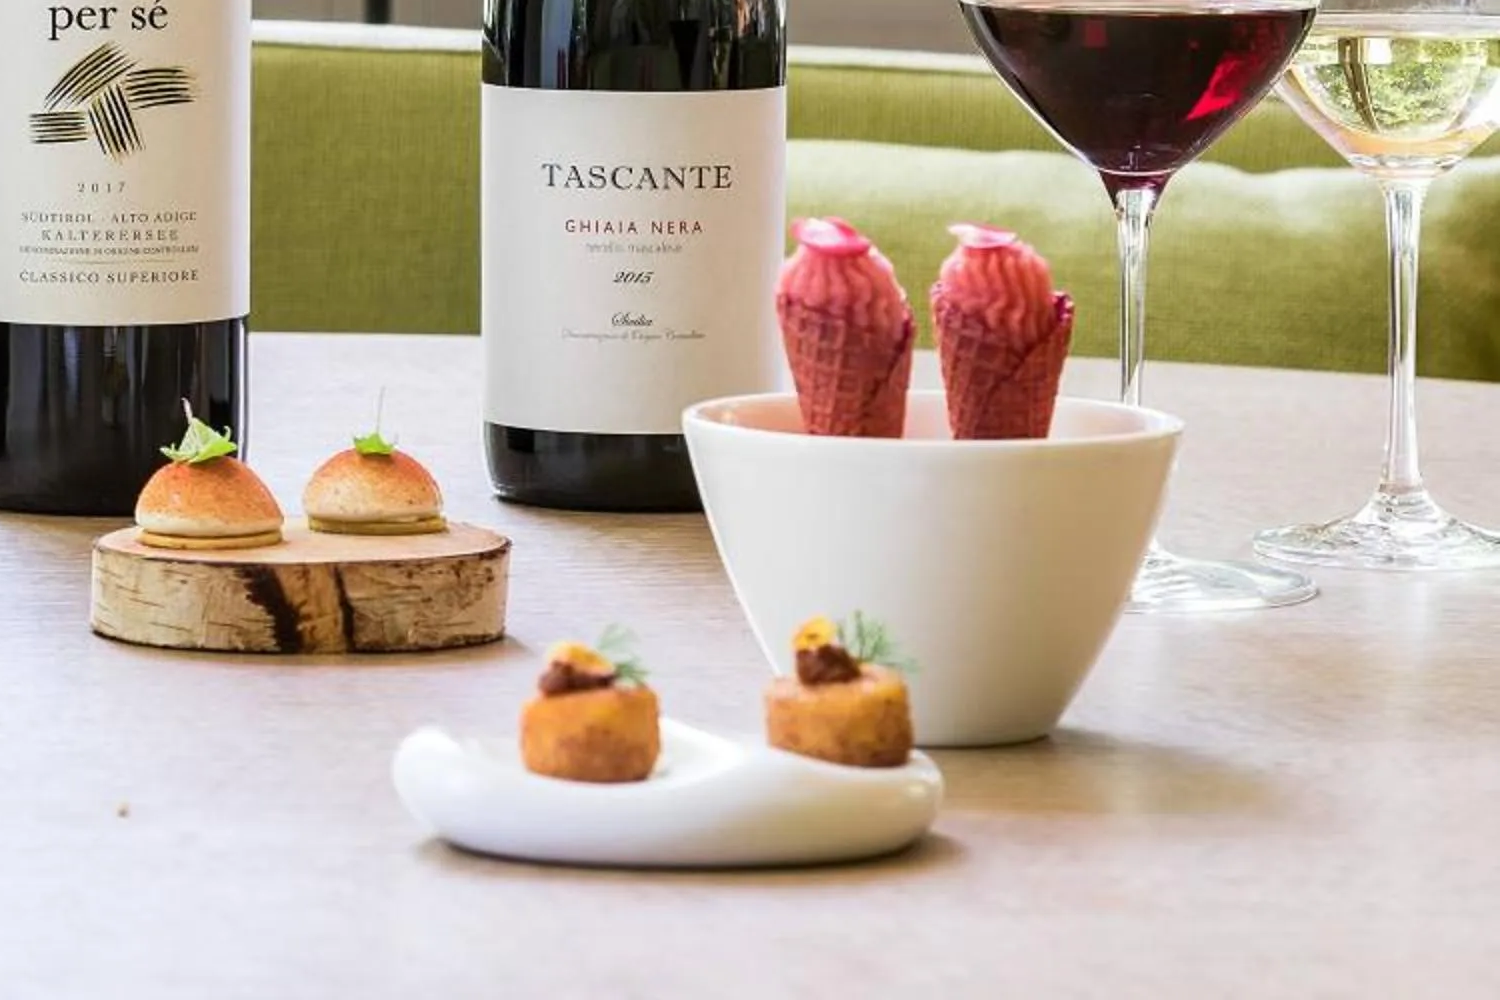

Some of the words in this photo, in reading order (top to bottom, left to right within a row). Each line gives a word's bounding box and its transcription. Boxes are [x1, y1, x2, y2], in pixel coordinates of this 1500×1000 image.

[48, 4, 118, 41] per
[542, 163, 733, 189] TASCANTE
[77, 182, 127, 194] 2017
[111, 212, 149, 224] ALTO
[153, 211, 197, 223] ADIGE
[565, 219, 638, 234] GHIAIA
[651, 220, 703, 235] NERA
[41, 229, 180, 242] KALTERERSEE
[19, 270, 100, 284] CLASSICO
[107, 269, 199, 283] SUPERIORE
[612, 271, 655, 284] 2015
